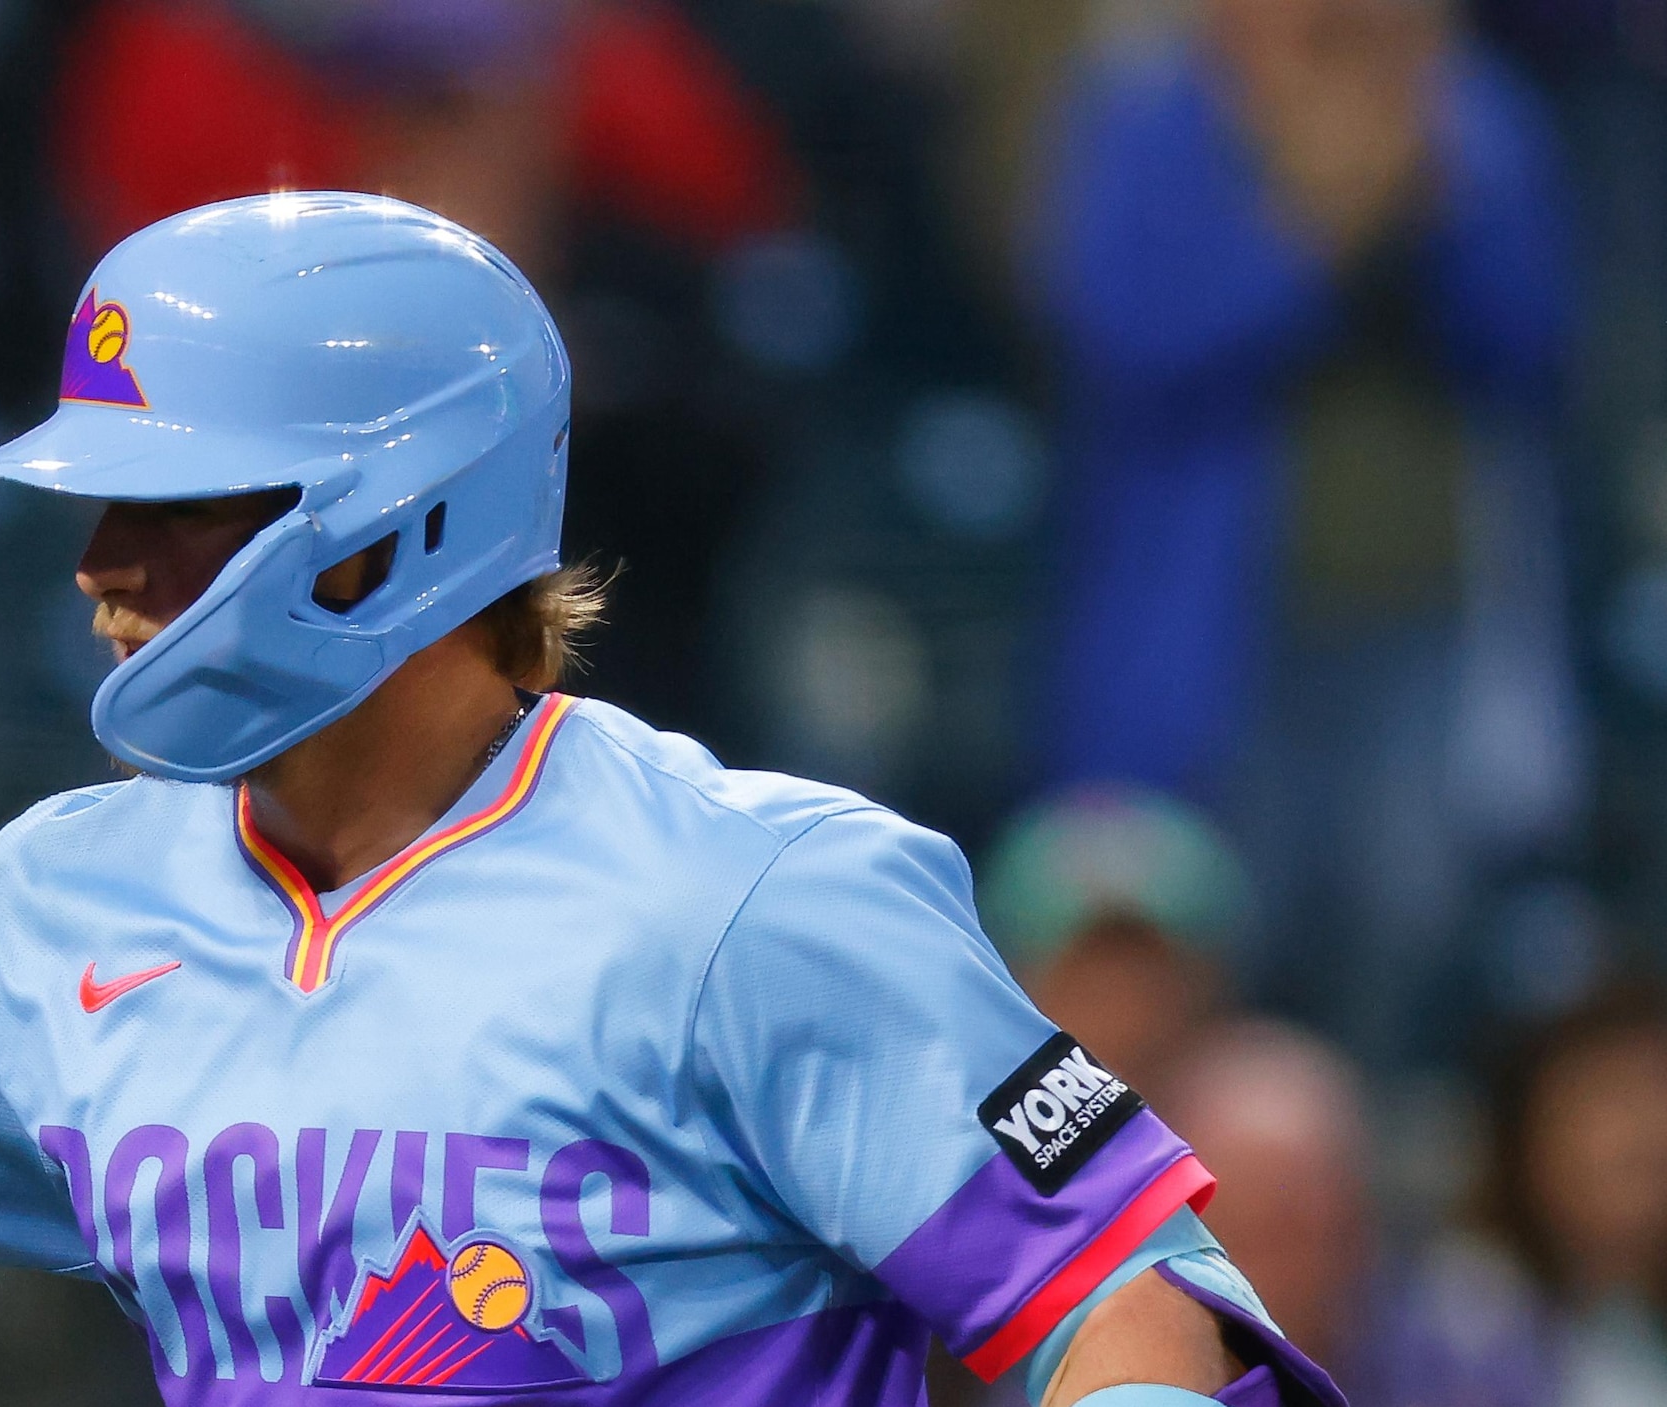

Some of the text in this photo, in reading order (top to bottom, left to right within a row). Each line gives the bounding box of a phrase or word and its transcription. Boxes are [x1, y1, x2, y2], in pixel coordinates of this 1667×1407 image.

[993, 1046, 1113, 1155] YORK
[1033, 1078, 1129, 1170] SPACE SYSTEMS
